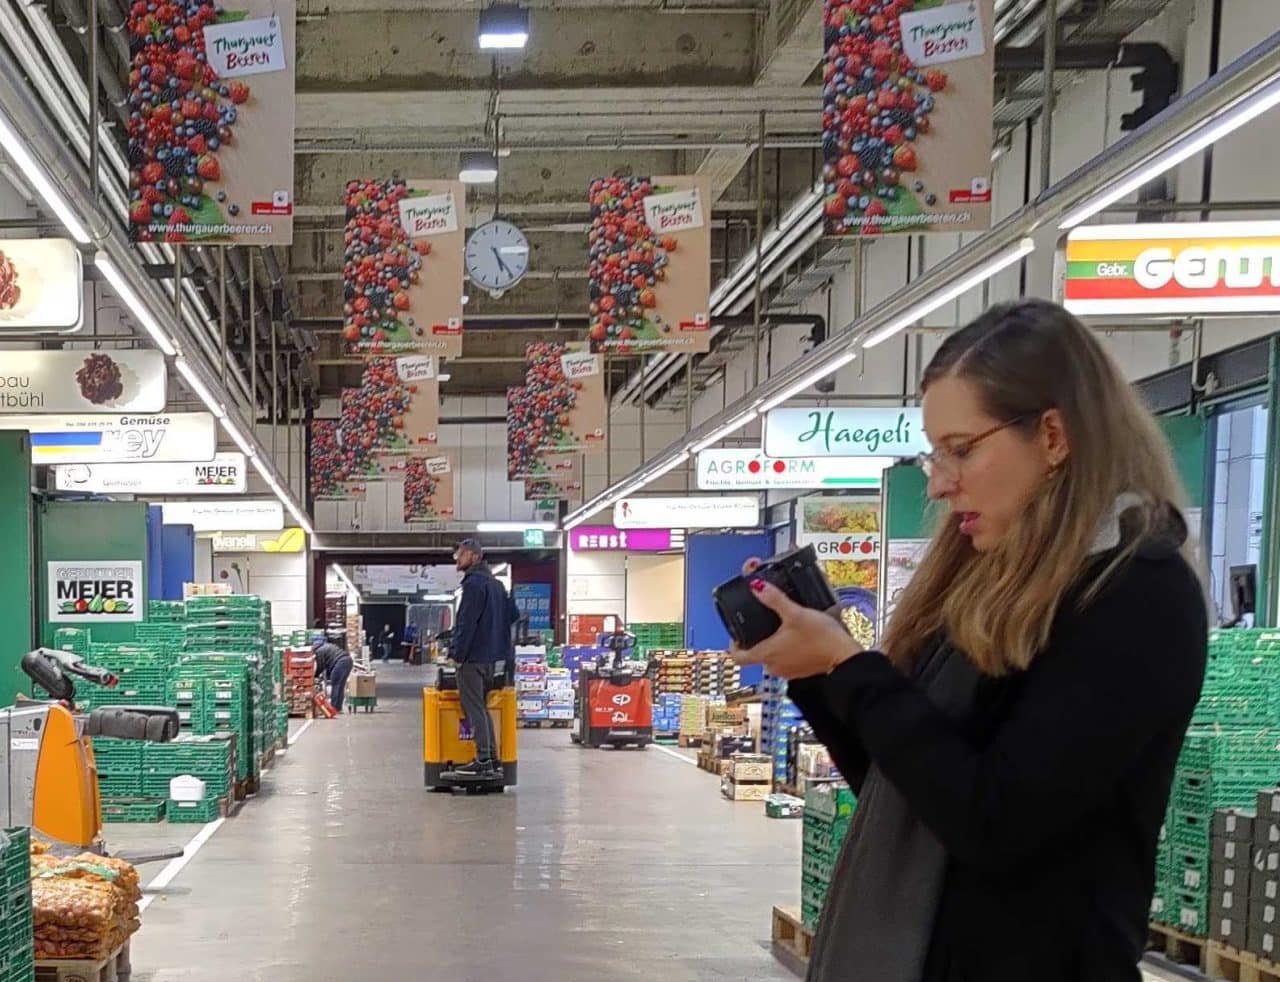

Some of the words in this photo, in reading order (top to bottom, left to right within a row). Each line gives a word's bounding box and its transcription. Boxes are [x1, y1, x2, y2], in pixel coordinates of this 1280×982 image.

[213, 33, 277, 53] Thurgauer
[226, 53, 271, 69] Beeren
[148, 222, 273, 235] www.thurgauerbeeren.ch
[1096, 262, 1129, 277] Gebr.
[119, 416, 170, 426] Gemüse
[798, 411, 911, 453] Haegeli
[195, 466, 237, 477] MEIER
[56, 580, 134, 599] MEIER
